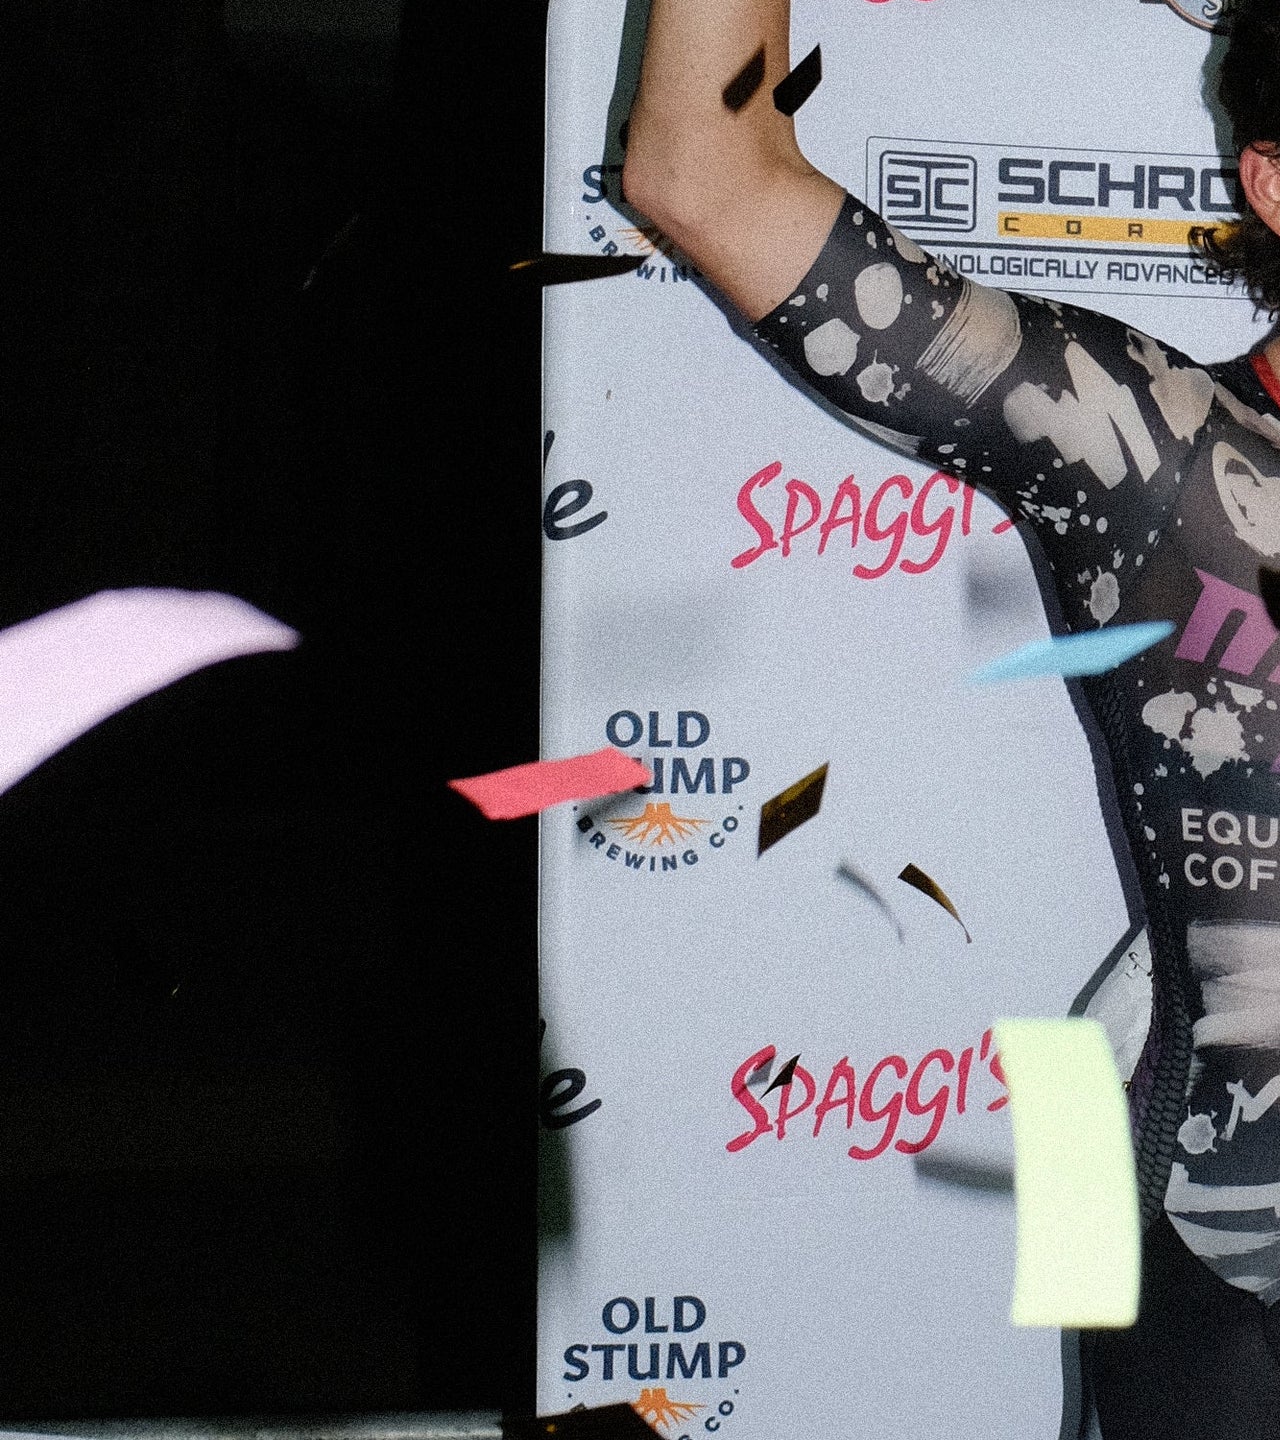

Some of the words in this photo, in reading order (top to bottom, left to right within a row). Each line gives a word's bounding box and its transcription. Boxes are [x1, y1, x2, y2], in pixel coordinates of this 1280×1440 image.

[998, 157, 1238, 213] SCHRO
[936, 253, 1100, 280] NOLOGICALLY
[730, 460, 1014, 580] SPAGGI
[605, 709, 711, 748] OLD
[633, 756, 751, 796] UMP
[574, 812, 699, 872] BREWING
[601, 1295, 707, 1335] OLD
[562, 1340, 747, 1383] STUMP
